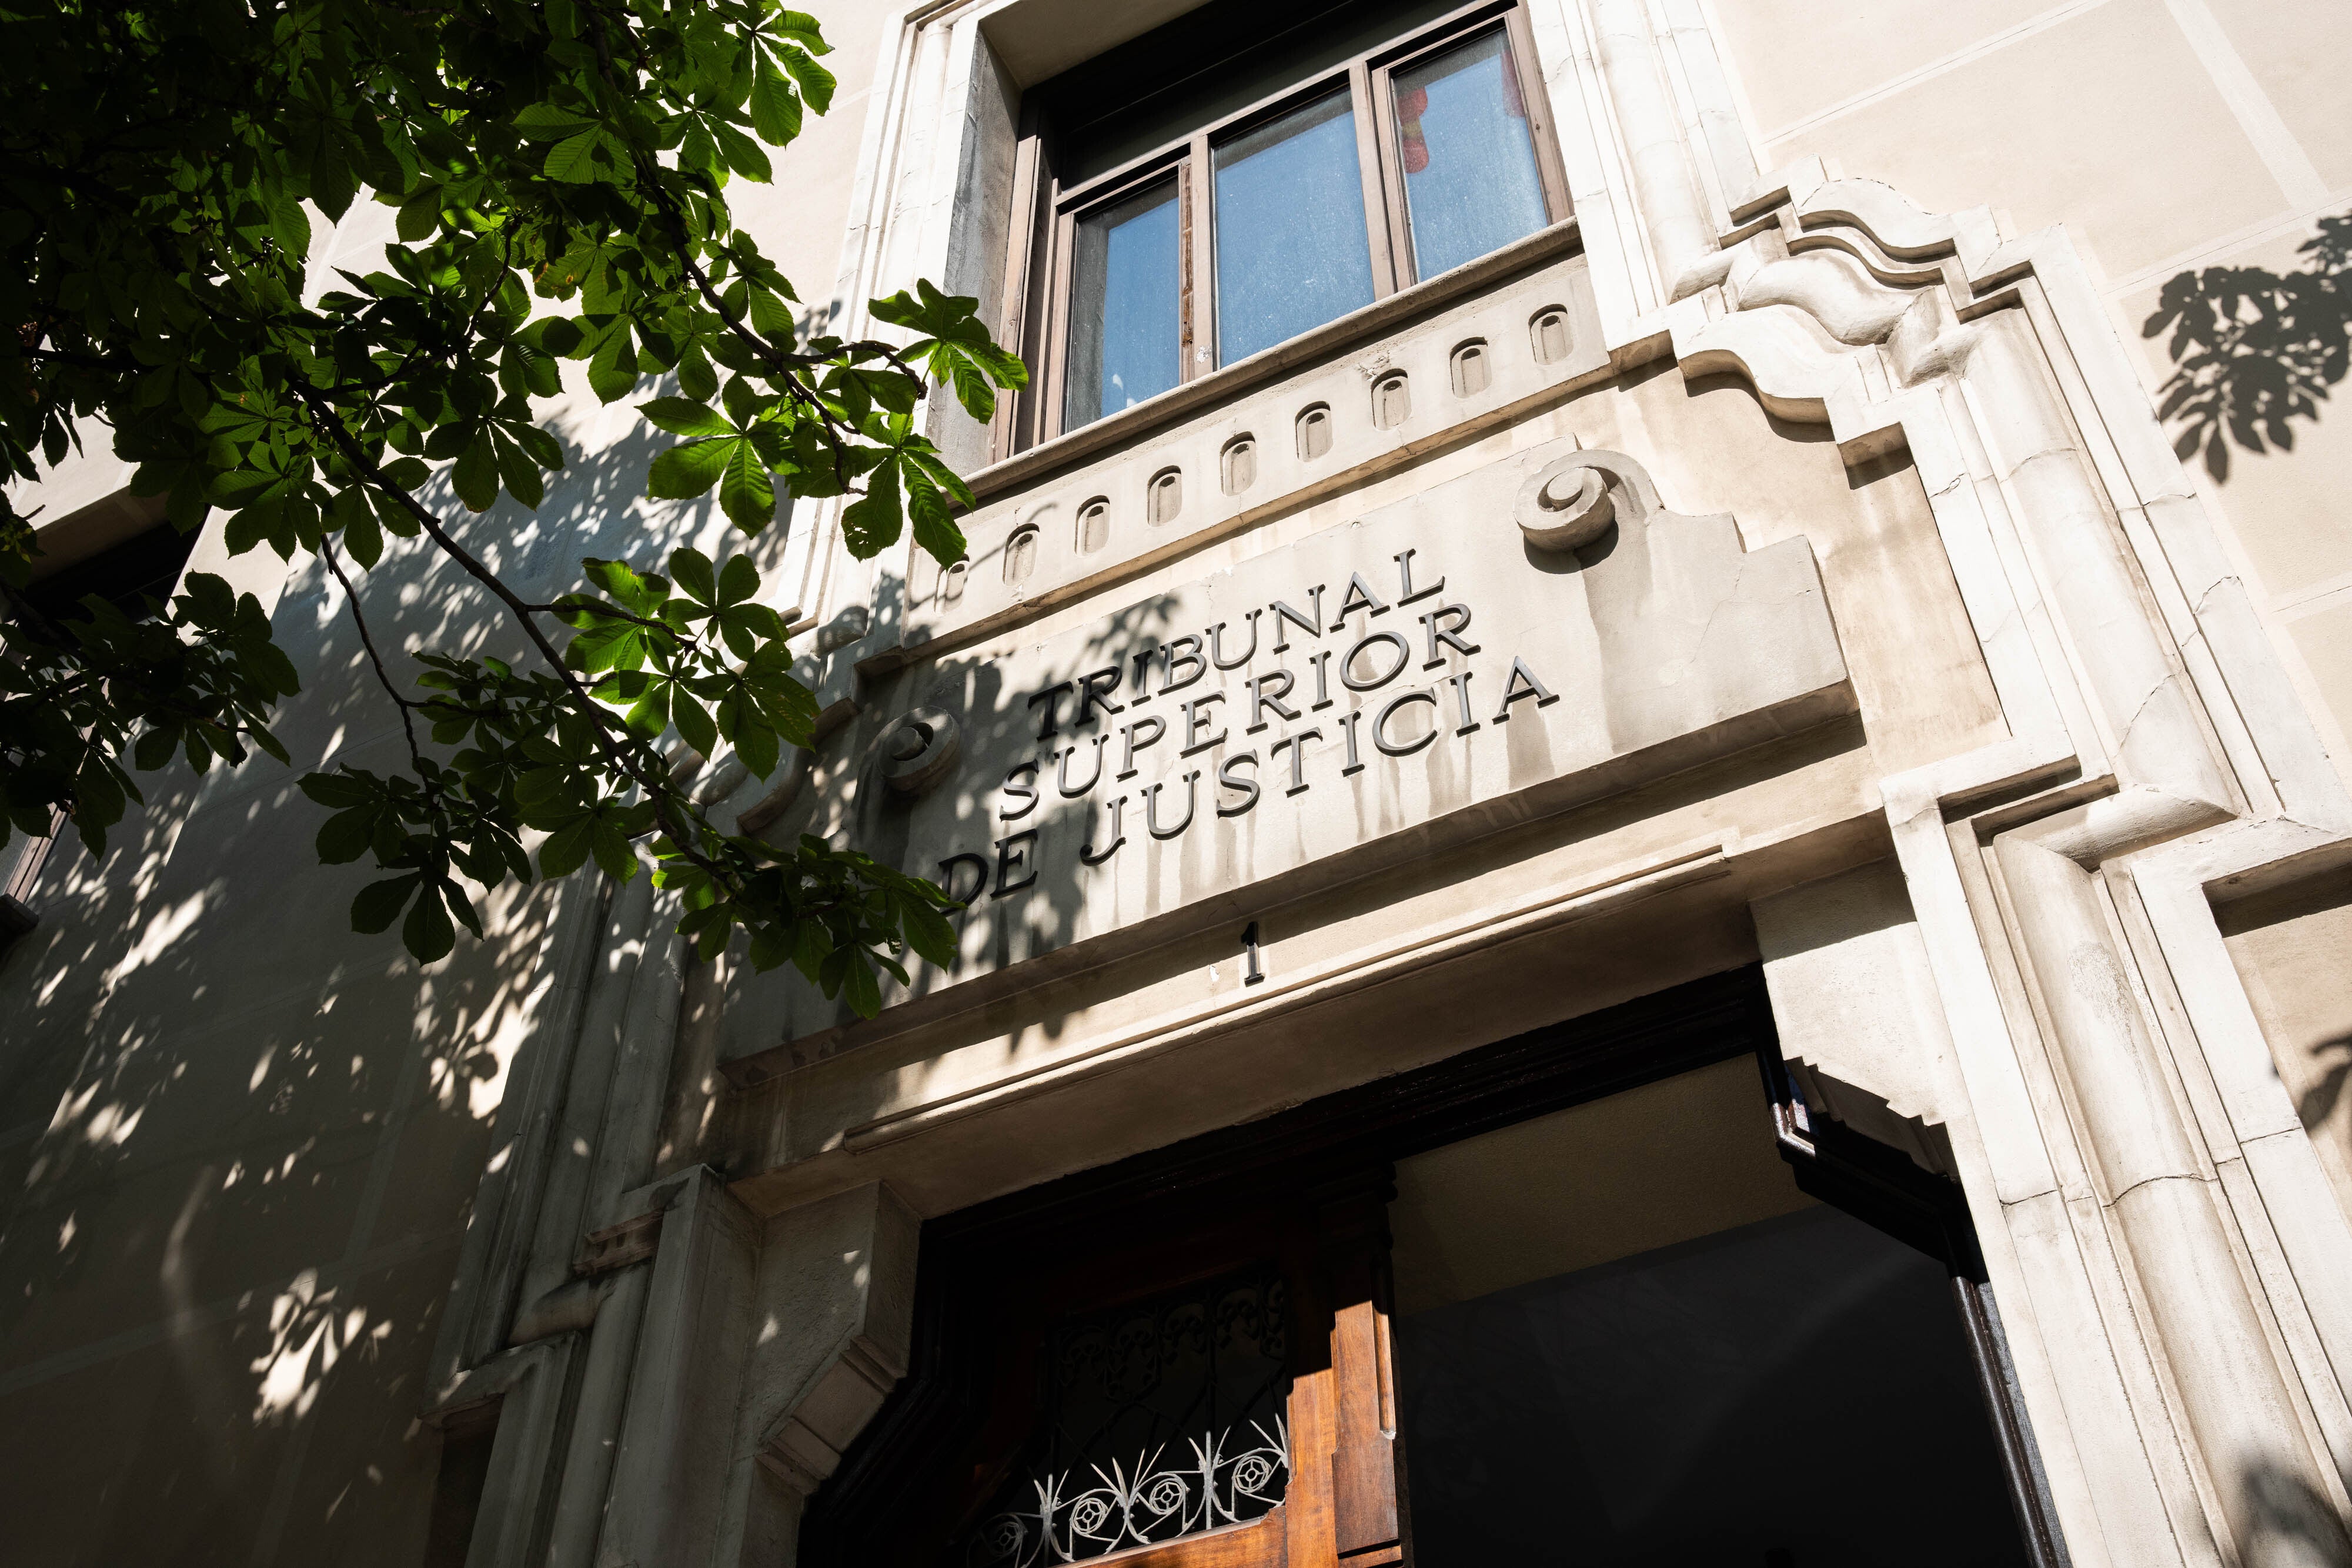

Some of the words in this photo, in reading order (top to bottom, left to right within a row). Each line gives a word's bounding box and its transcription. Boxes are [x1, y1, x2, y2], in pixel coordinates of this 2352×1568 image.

[999, 604, 1481, 821] SUPERIOR
[1028, 549, 1445, 740] TRIBUNAL
[938, 828, 1038, 916] DE
[1080, 656, 1560, 866] JUSTICIA
[1241, 921, 1265, 987] 1
